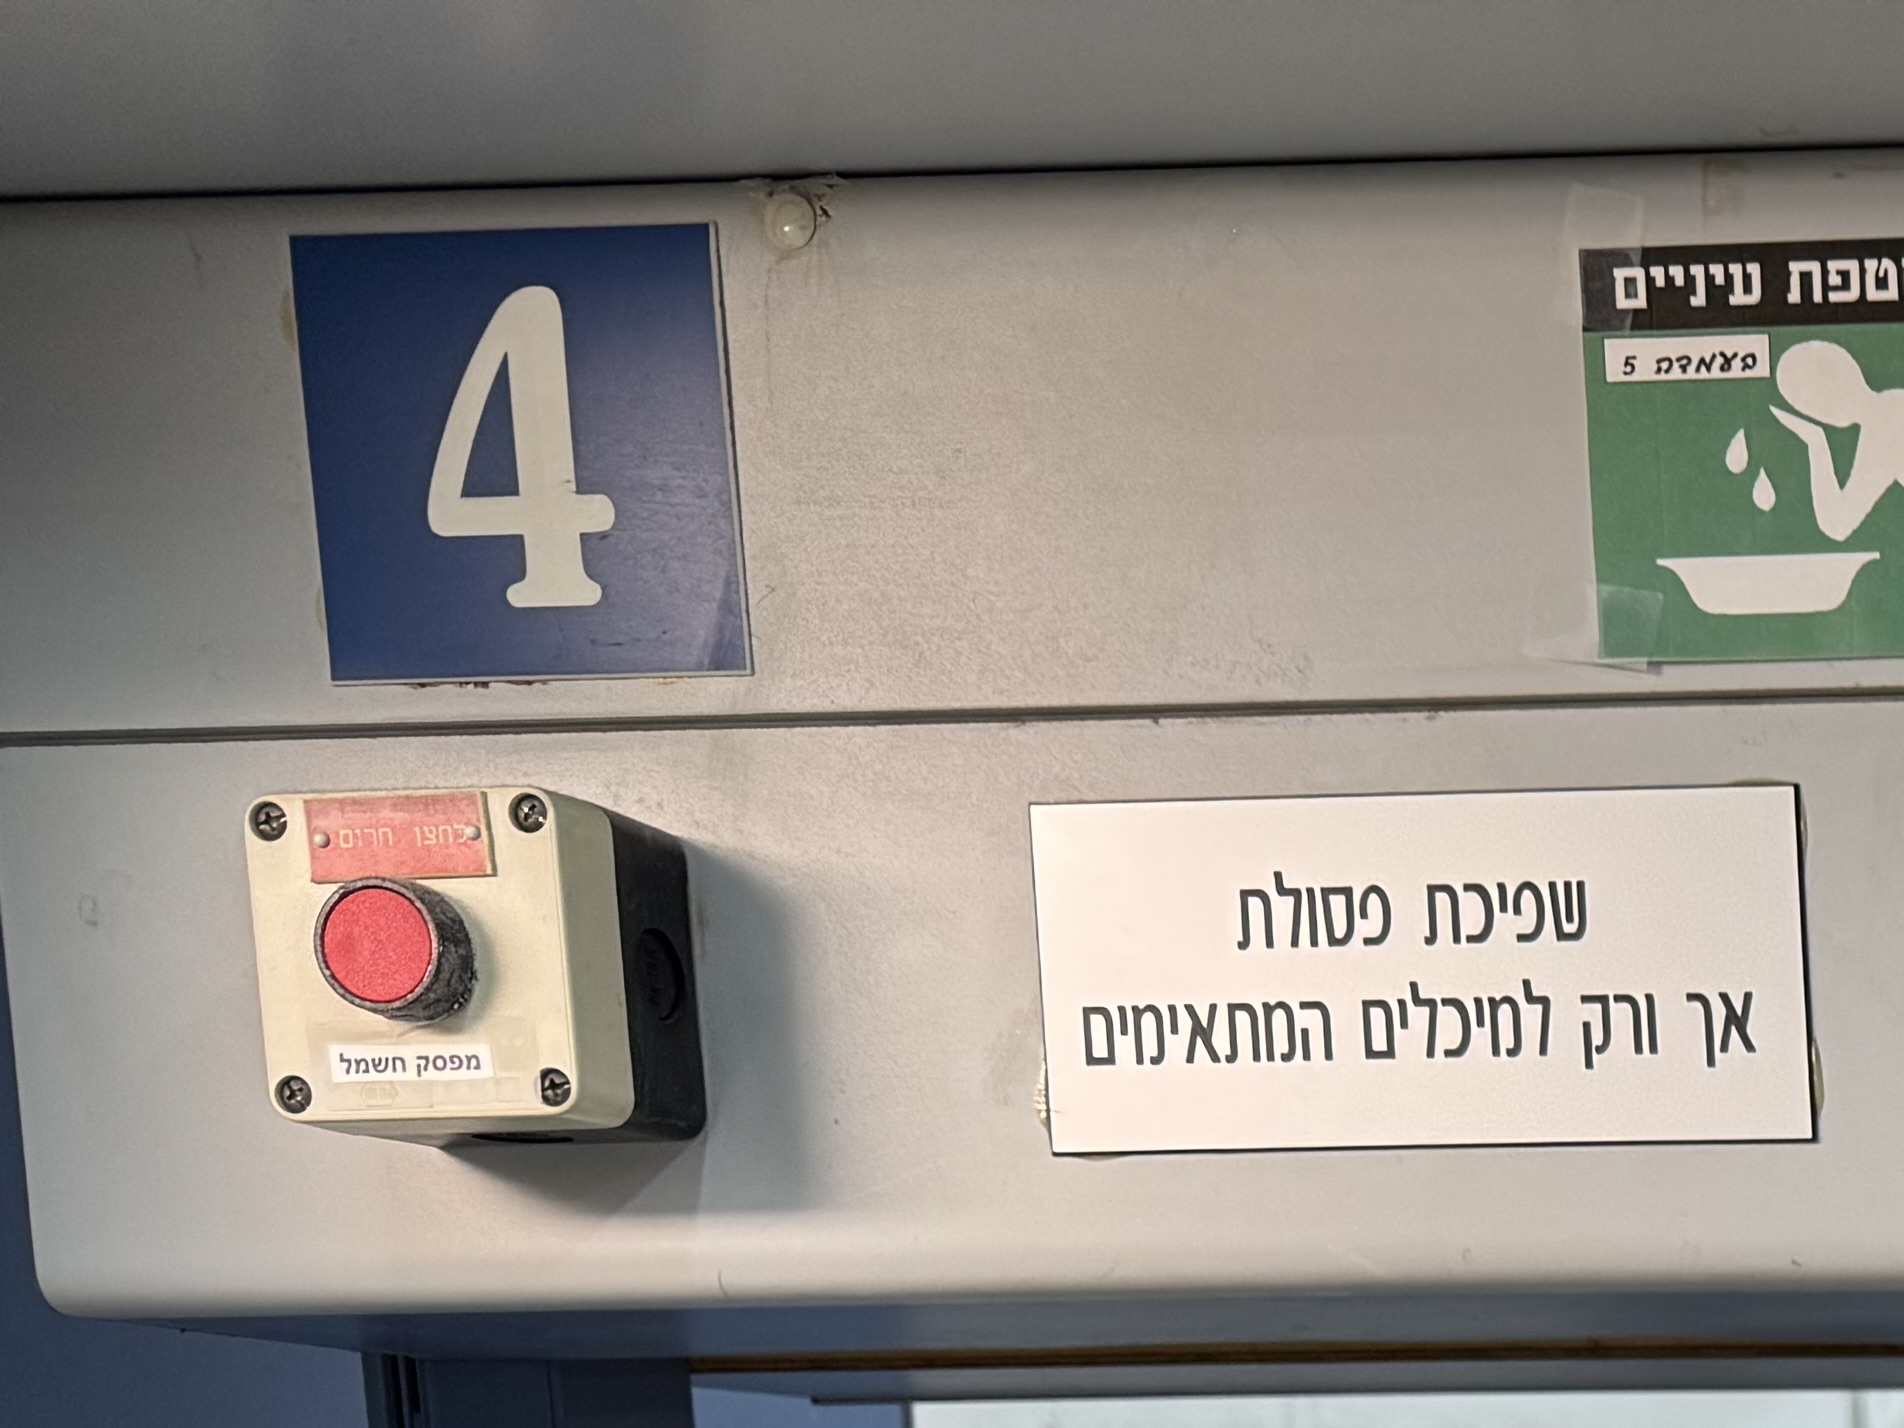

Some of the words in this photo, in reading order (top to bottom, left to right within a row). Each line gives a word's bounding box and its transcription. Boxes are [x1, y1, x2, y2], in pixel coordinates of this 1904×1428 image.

[1612, 260, 1762, 310] עיניים
[1622, 355, 1637, 376] 5
[1654, 350, 1758, 376] בעמדה
[428, 286, 615, 607] 4
[338, 827, 394, 849] חרום
[1237, 870, 1392, 951] פסולת
[1424, 879, 1587, 947] שפיכת
[1081, 999, 1334, 1067] המתאימים
[1361, 978, 1552, 1062] למיכלים
[1580, 993, 1659, 1070] ורק
[1686, 991, 1757, 1069] אך
[338, 1052, 407, 1076] חשמל
[416, 1054, 482, 1078] מפסק
